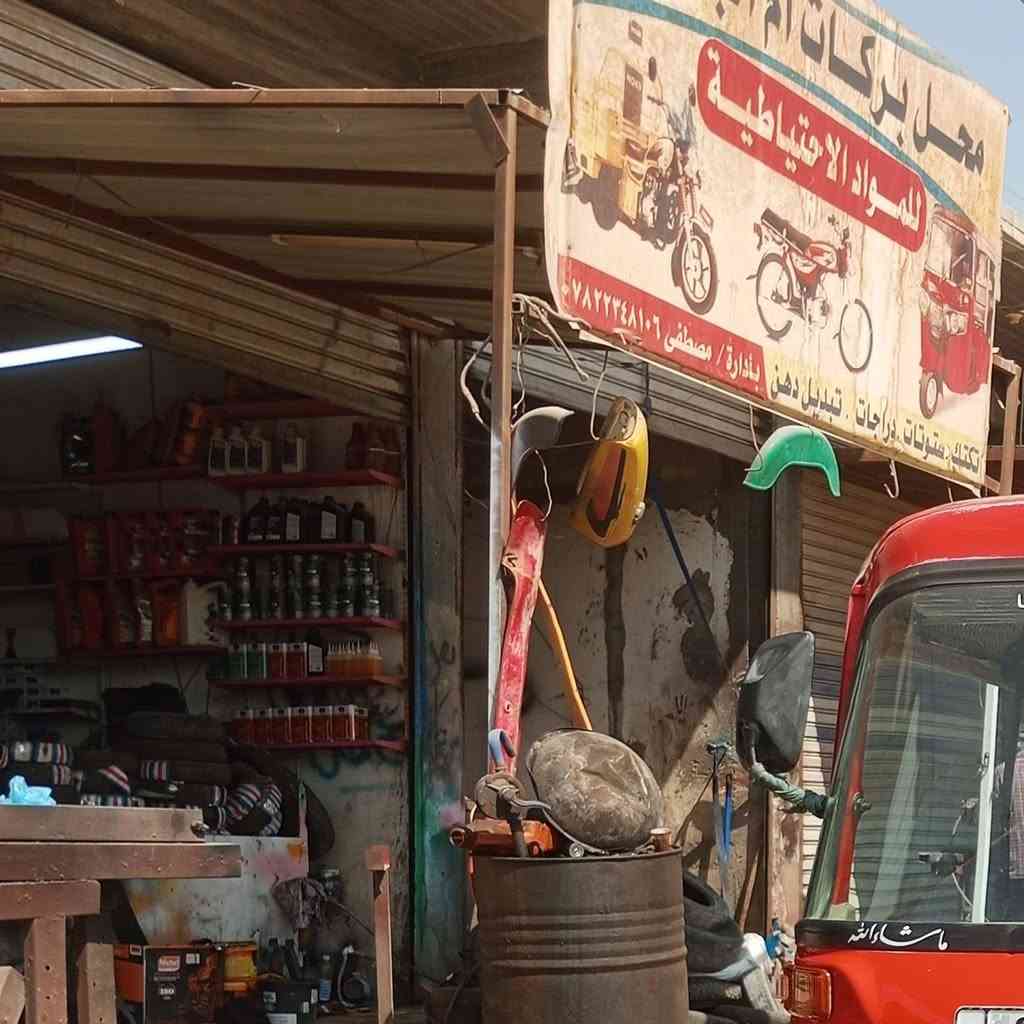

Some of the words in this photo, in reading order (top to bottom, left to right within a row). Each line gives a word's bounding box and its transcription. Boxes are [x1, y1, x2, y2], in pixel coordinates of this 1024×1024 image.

[707, 47, 849, 188] الاحتياطية
[800, 0, 908, 147] بركات
[912, 82, 985, 176] محل
[852, 158, 922, 232] للمواد
